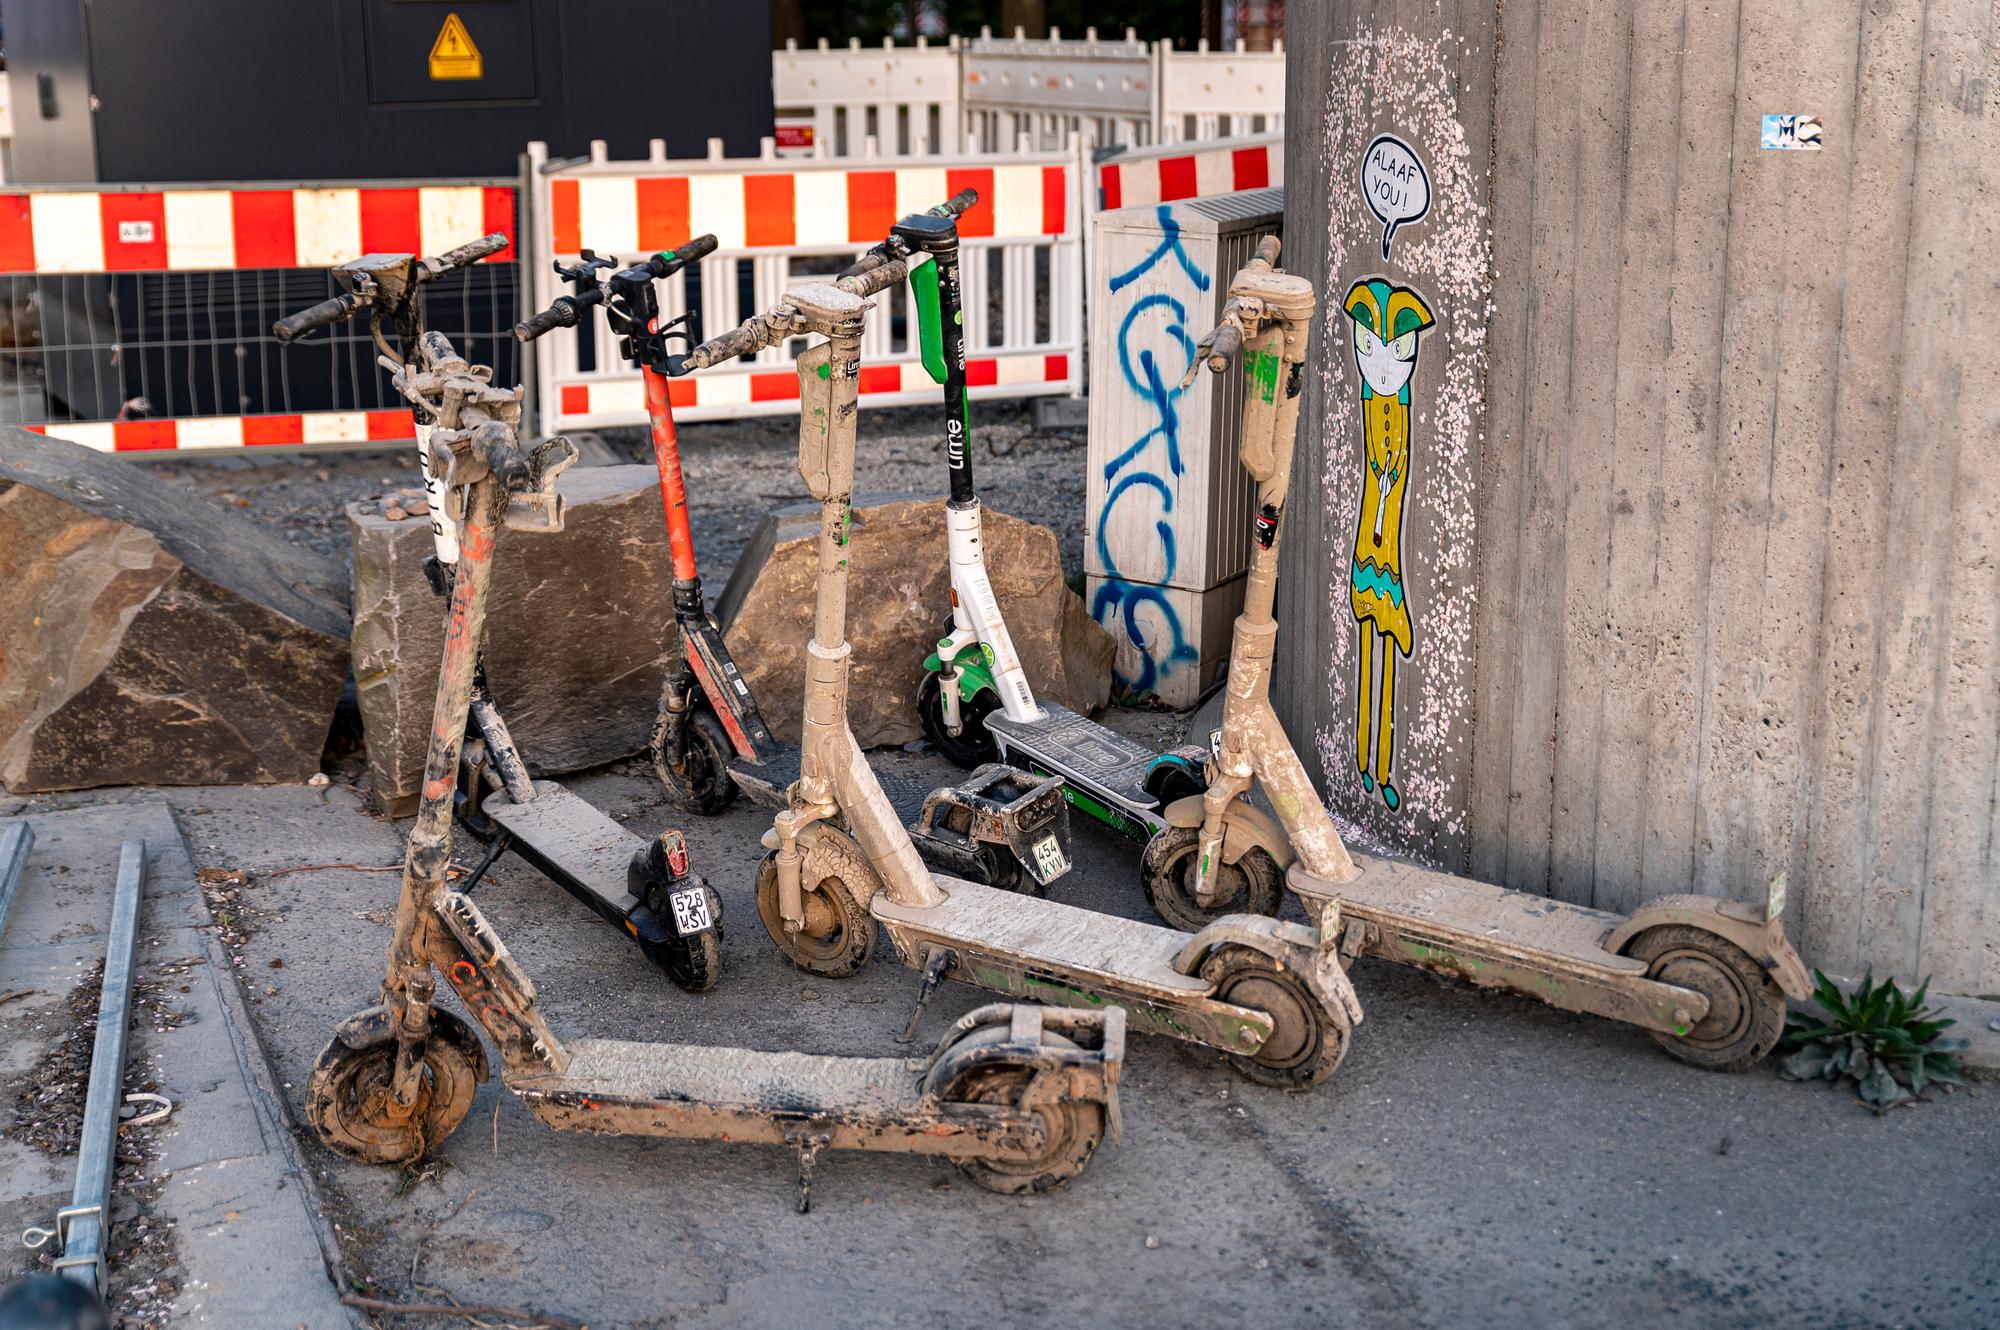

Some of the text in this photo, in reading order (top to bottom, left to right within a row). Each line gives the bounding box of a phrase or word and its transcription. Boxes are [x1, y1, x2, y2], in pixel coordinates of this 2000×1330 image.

[1373, 149, 1417, 184] ALAAF
[947, 419, 964, 470] Lime
[1038, 840, 1057, 860] 454
[1043, 855, 1063, 877] KYV
[675, 892, 703, 912] 528
[680, 910, 706, 928] WSV
